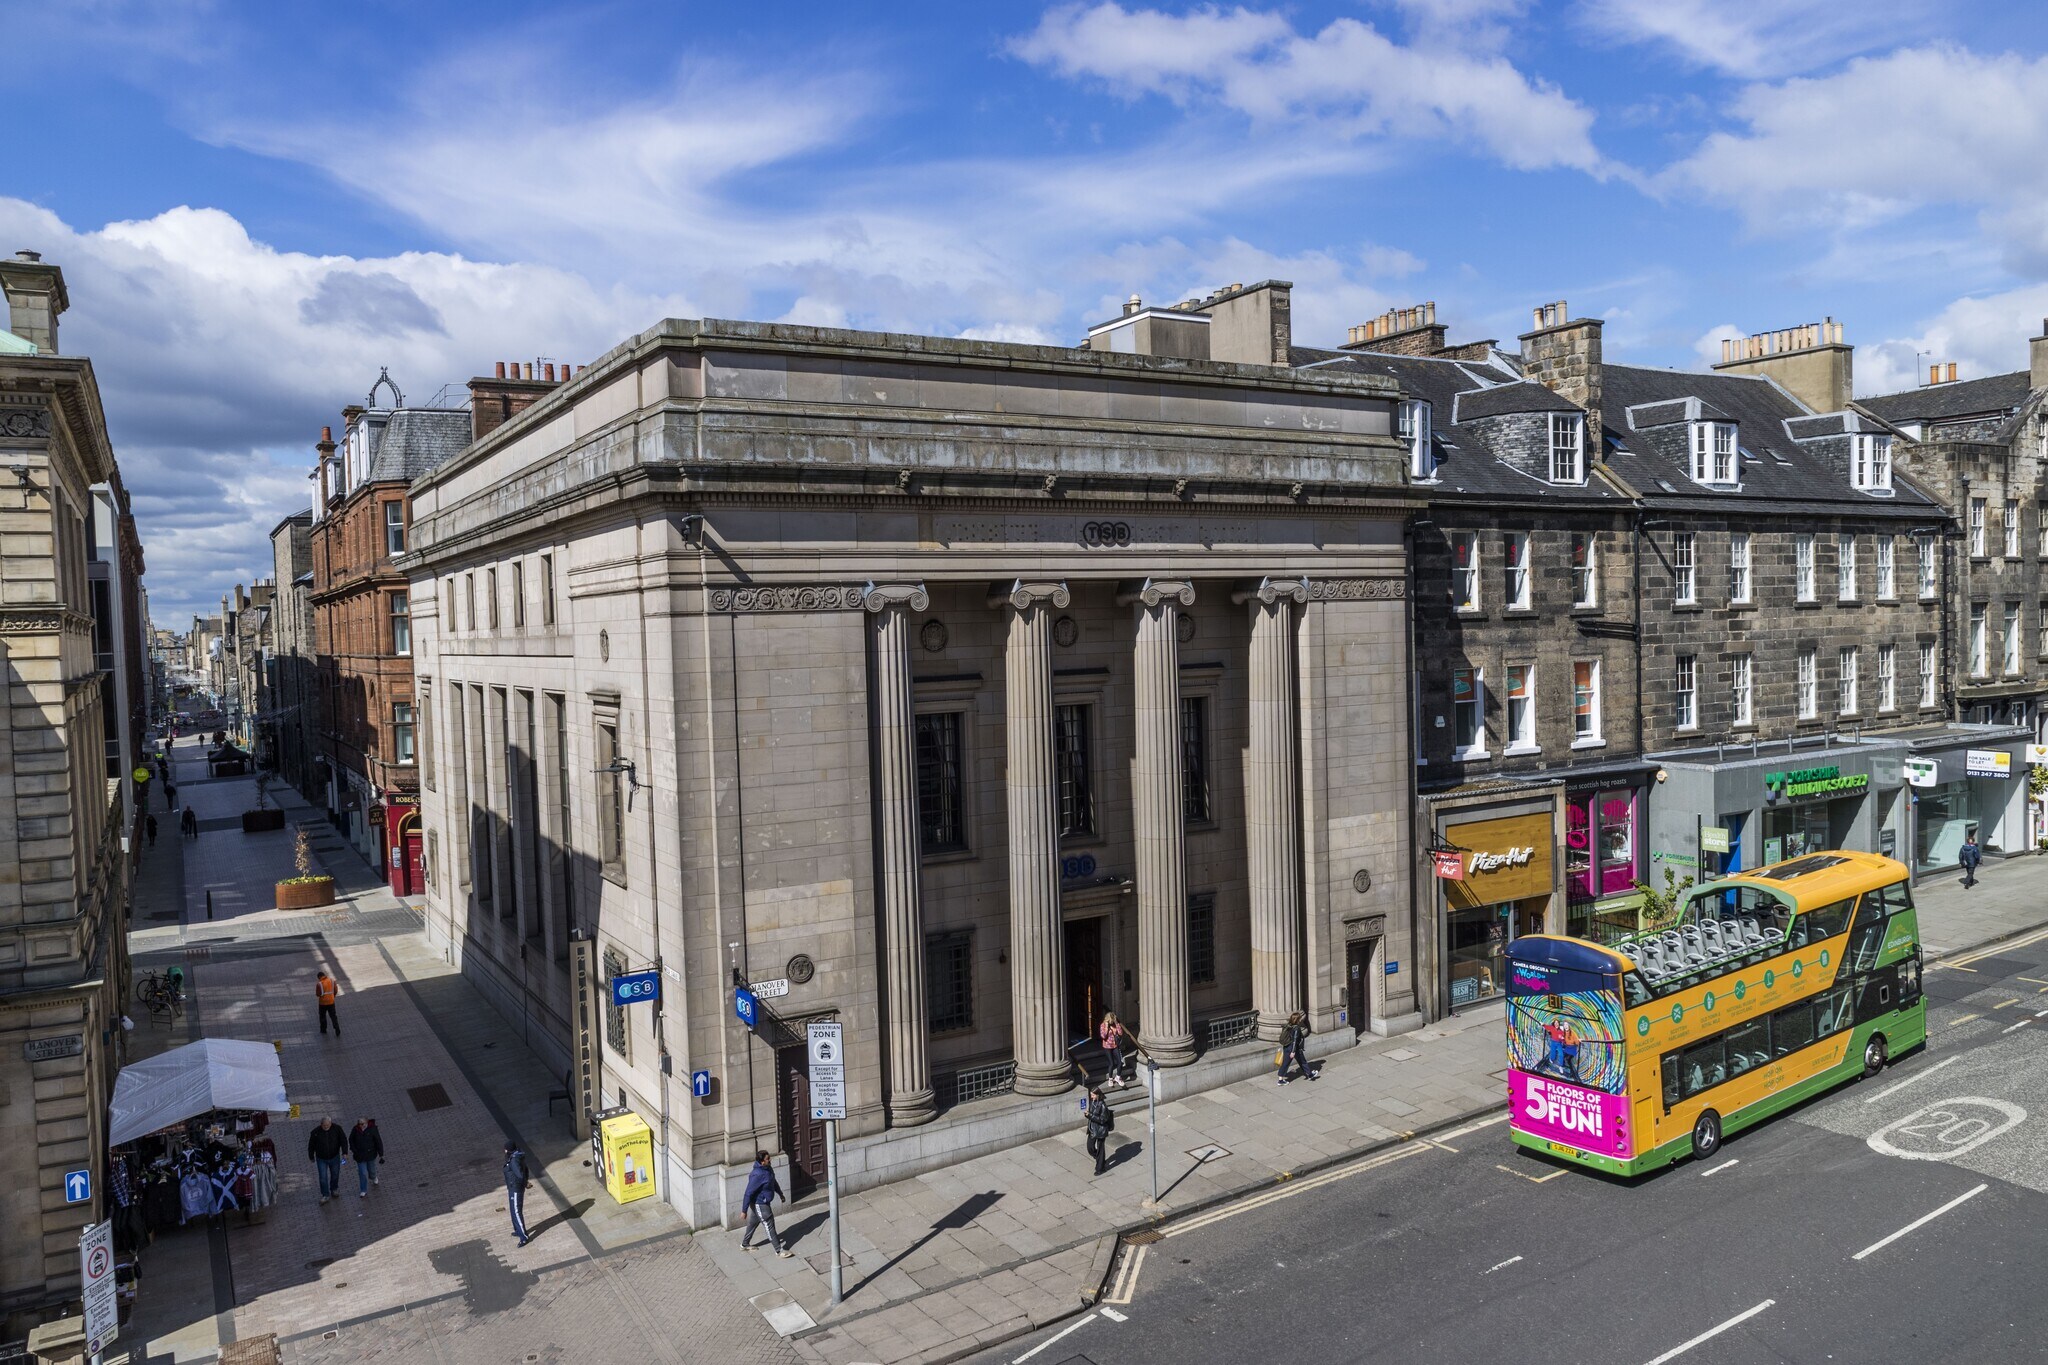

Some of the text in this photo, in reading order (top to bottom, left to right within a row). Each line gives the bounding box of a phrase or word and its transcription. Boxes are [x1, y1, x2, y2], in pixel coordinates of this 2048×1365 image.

[1085, 524, 1128, 543] TSB
[1787, 766, 1840, 782] YORKSHIRE
[1579, 780, 1599, 789] scottish
[1786, 780, 1830, 796] BUILDING
[1704, 838, 1726, 846] store
[1439, 854, 1459, 866] Pizza
[1469, 847, 1533, 874] Pizza Hut
[1441, 866, 1456, 875] Hut
[1888, 934, 1912, 949] EDINBURGH
[621, 981, 652, 996] TSB
[737, 998, 751, 1016] TSB
[29, 1037, 77, 1051] HANOVER
[1635, 1039, 1650, 1048] PALACE
[35, 1046, 72, 1058] STREET
[1764, 1070, 1774, 1078] HOP
[1764, 1075, 1784, 1088] HOP OFF
[1525, 1077, 1548, 1120] 5
[1547, 1082, 1601, 1104] FLOORS OF
[1548, 1093, 1601, 1113] INTERACTIVE
[1548, 1101, 1602, 1137] FUN!
[1898, 1112, 1990, 1144] 20
[82, 1222, 110, 1243] PEDESTRIAN
[86, 1233, 107, 1251] ZONE
[95, 1292, 106, 1302] Lanes
[90, 1301, 104, 1314] Except
[93, 1306, 109, 1318] loading
[105, 1336, 113, 1345] time
